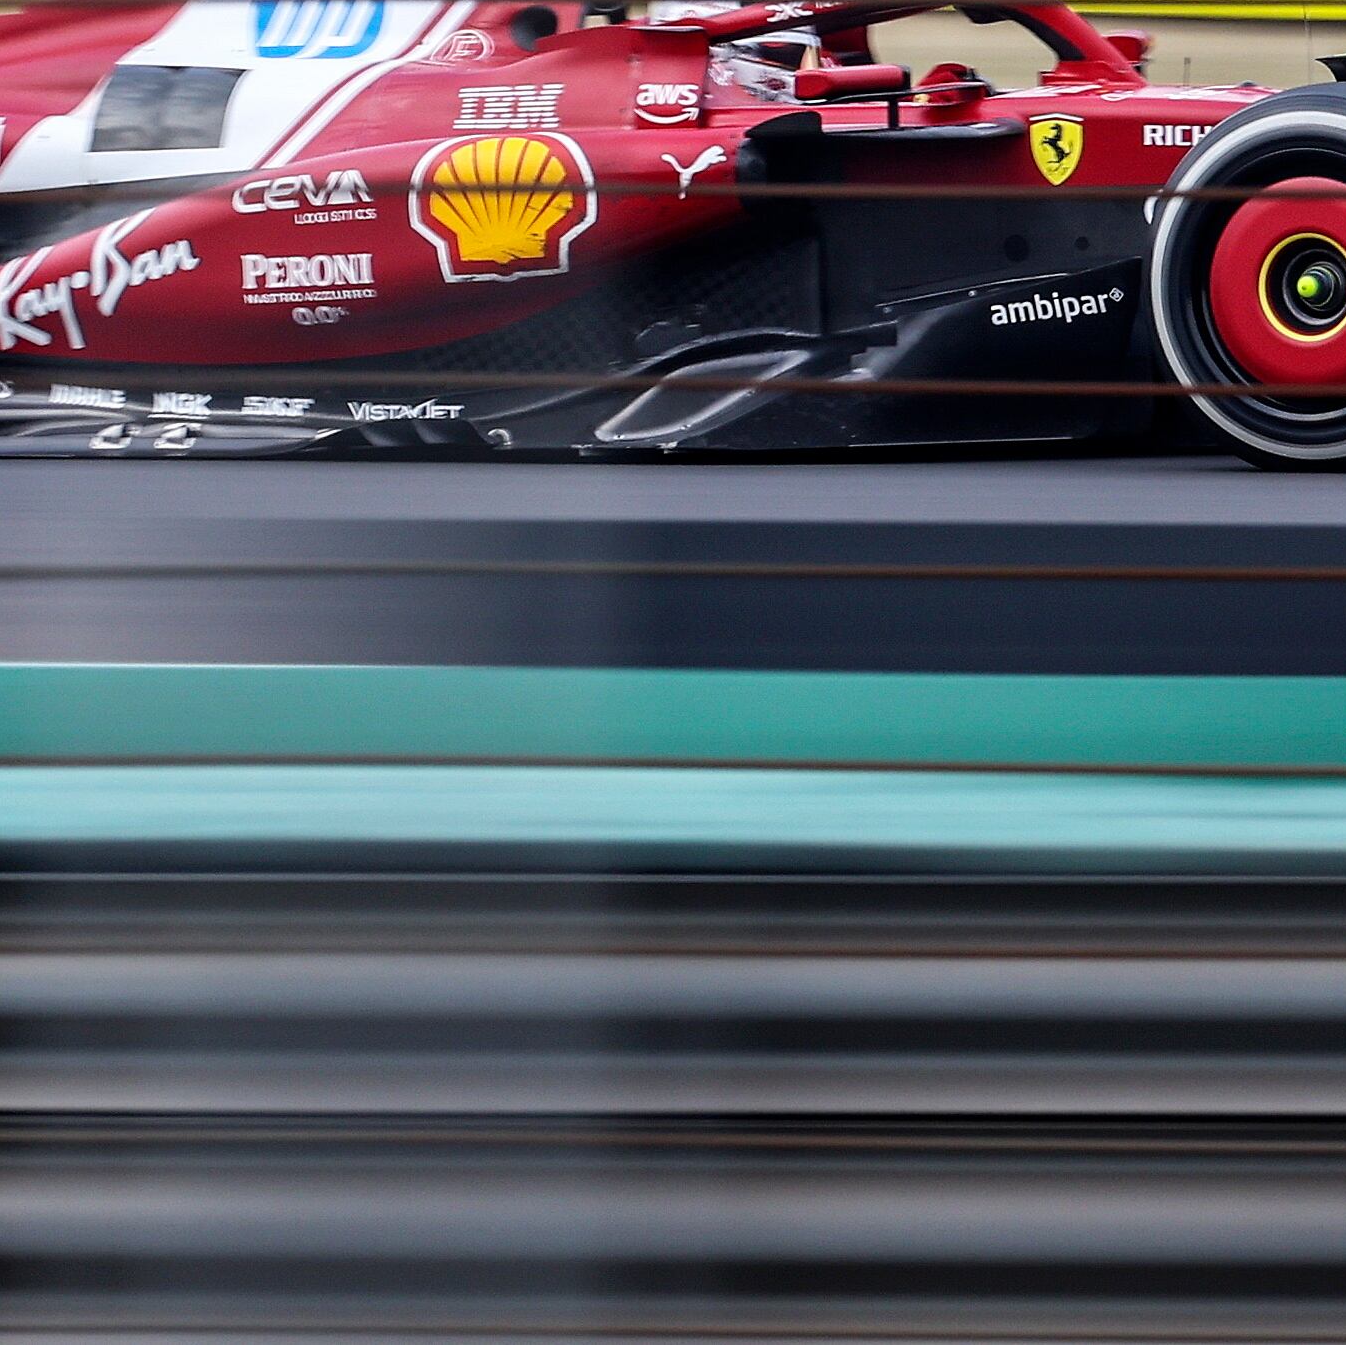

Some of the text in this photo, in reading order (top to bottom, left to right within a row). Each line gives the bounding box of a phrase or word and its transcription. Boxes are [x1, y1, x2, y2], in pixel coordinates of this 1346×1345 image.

[453, 83, 566, 129] IBM
[637, 84, 699, 105] aws
[240, 253, 375, 289] PERONI
[990, 292, 1108, 325] ambipar
